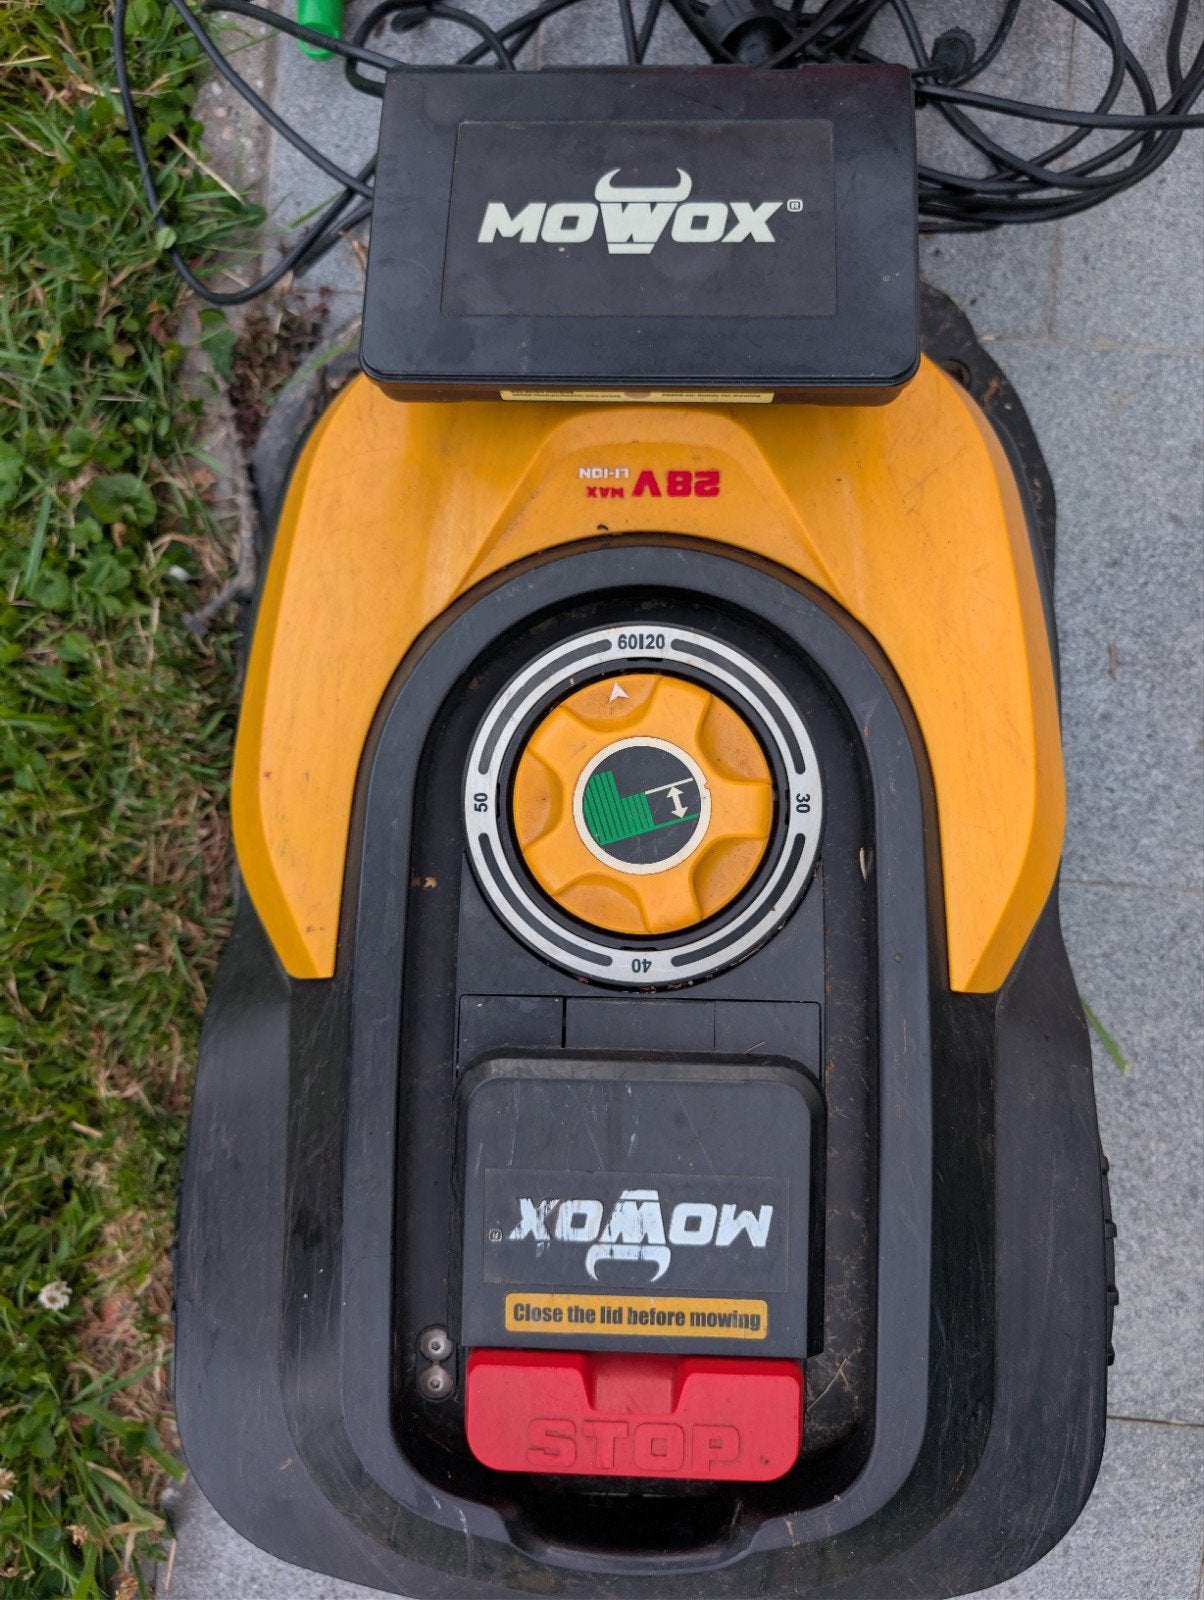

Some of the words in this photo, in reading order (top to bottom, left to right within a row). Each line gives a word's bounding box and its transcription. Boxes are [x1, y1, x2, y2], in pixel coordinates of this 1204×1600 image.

[478, 201, 784, 254] MOWOX
[578, 467, 629, 479] LI-ION
[631, 470, 720, 497] 28V
[586, 486, 624, 498] MAX
[473, 792, 489, 813] 50
[796, 793, 811, 814] 30
[631, 959, 652, 973] 40
[508, 1190, 773, 1248] MOWOX
[513, 1303, 563, 1323] Close
[567, 1305, 596, 1324] the
[600, 1306, 623, 1324] lid
[627, 1307, 686, 1327] before
[690, 1311, 761, 1331] mowing
[526, 1418, 741, 1472] STOP
